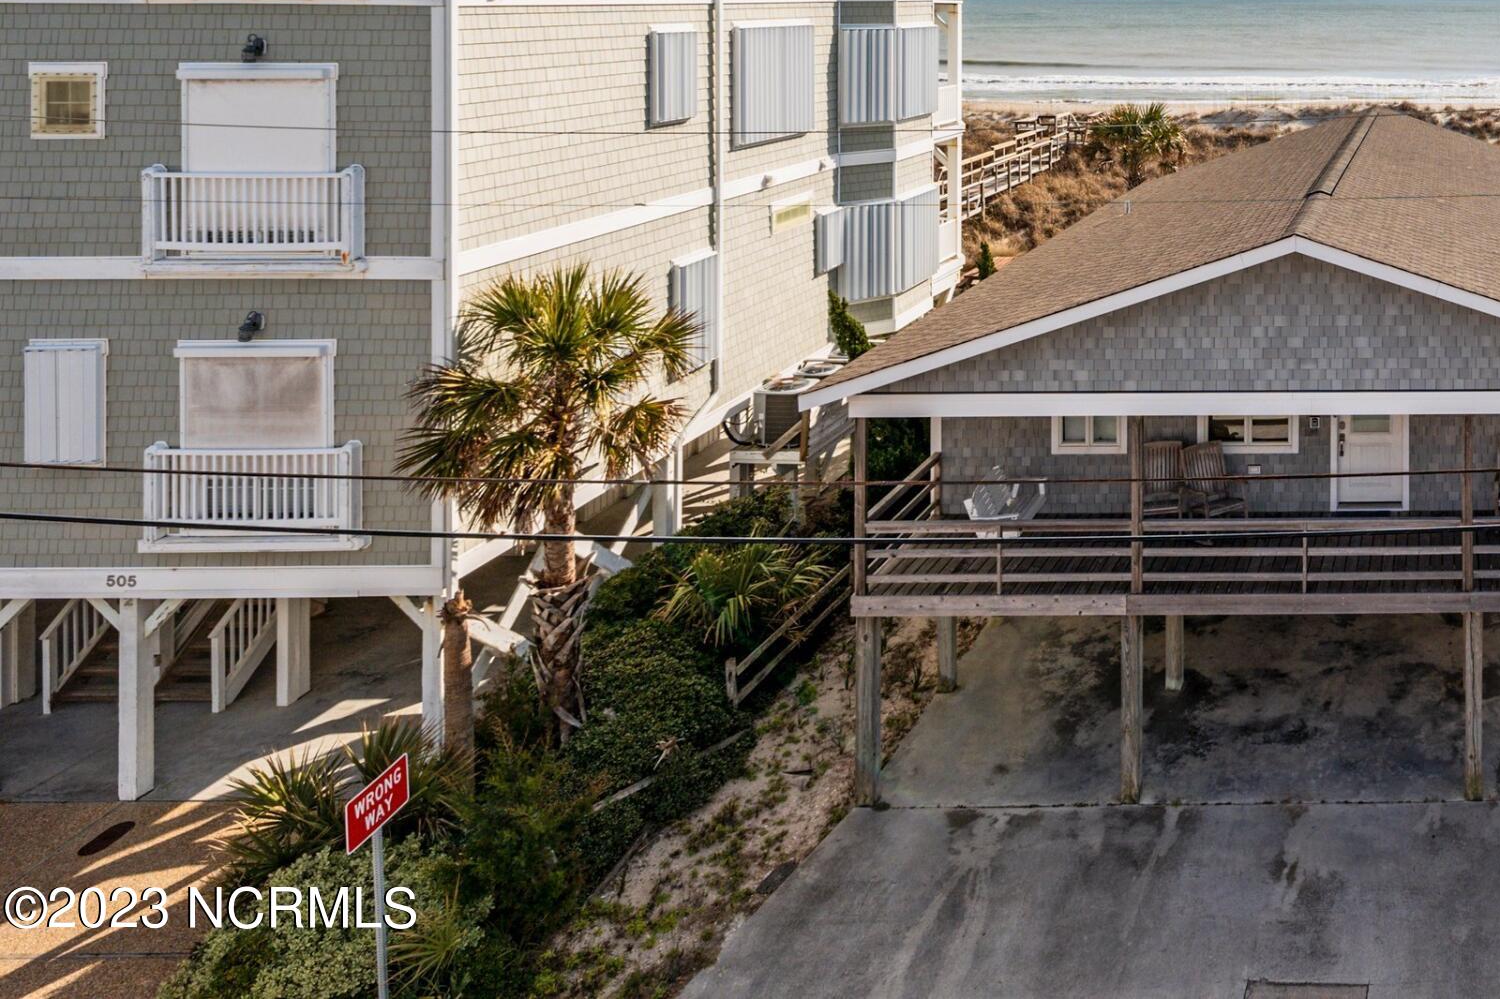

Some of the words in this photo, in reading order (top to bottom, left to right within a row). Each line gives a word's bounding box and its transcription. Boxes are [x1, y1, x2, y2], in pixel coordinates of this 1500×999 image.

[106, 574, 137, 588] 505
[354, 766, 402, 819] WRONG
[364, 792, 394, 831] WAY
